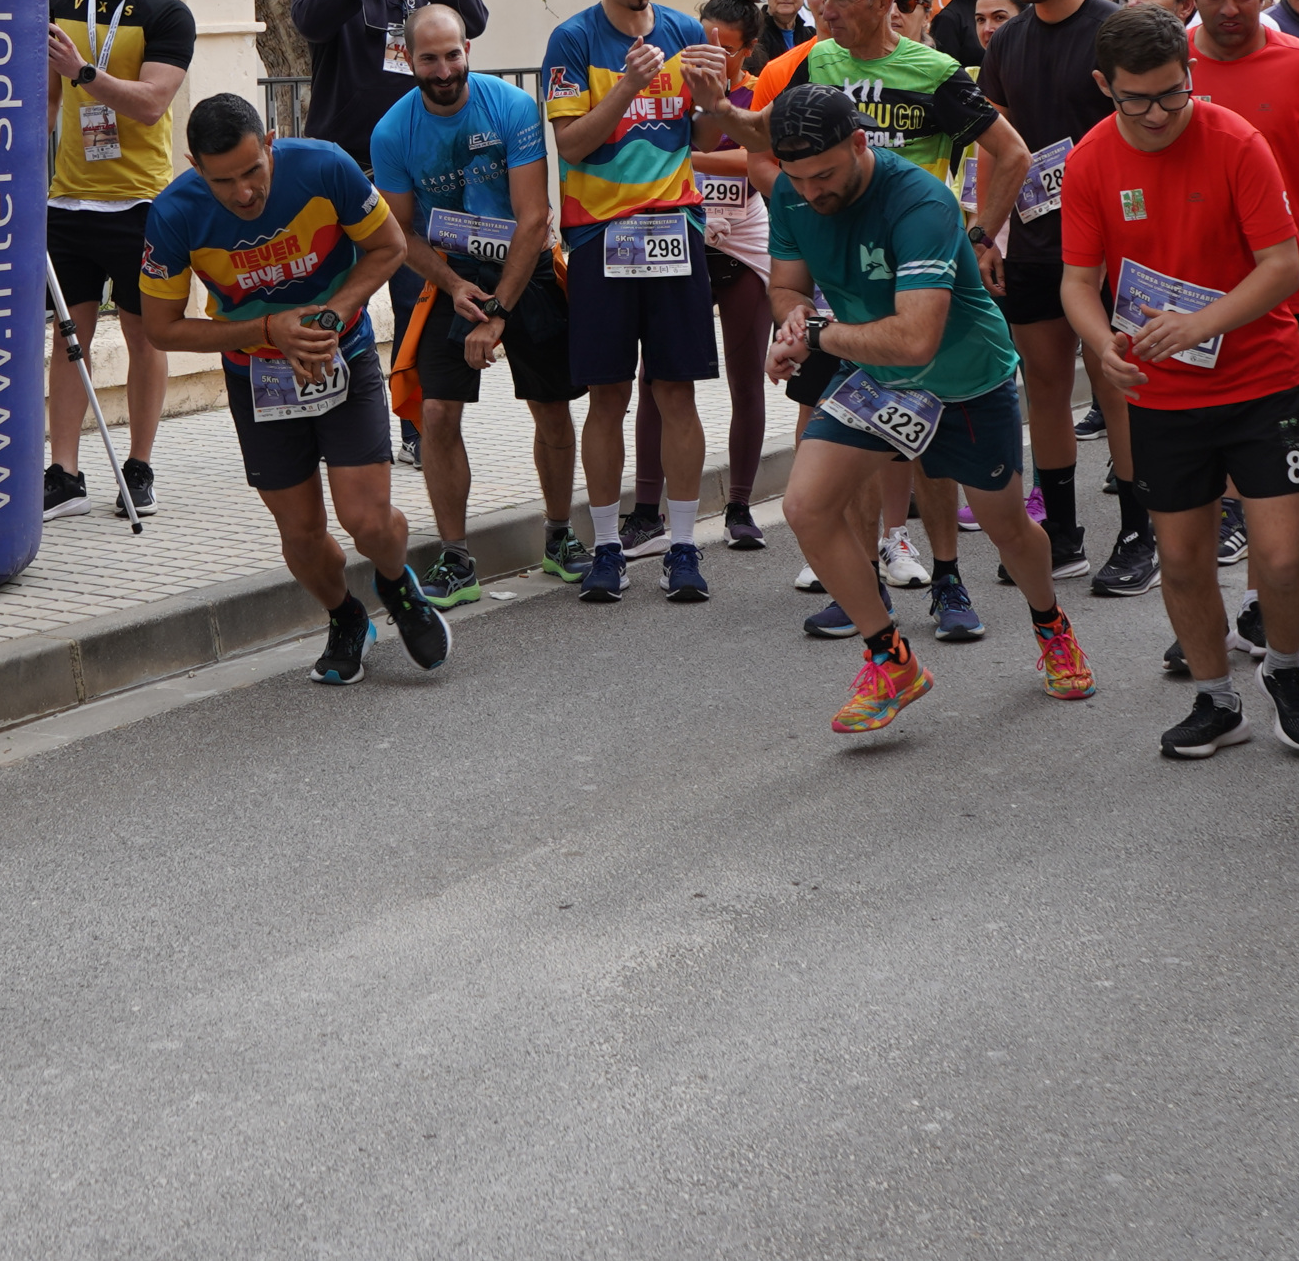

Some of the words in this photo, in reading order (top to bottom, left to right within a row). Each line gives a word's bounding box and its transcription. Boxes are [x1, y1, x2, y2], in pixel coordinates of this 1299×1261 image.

[123, 4, 134, 17] S
[622, 96, 656, 120] IVE
[661, 96, 684, 118] UP
[1042, 167, 1066, 193] 28
[704, 182, 741, 201] 299
[438, 230, 458, 239] 5Km
[228, 234, 302, 270] NEVER
[470, 239, 508, 260] 300
[646, 238, 682, 258] 298
[235, 264, 285, 290] GIVE
[290, 251, 319, 279] UP
[1129, 286, 1151, 303] 5Km
[261, 374, 280, 384] 5Km
[860, 379, 880, 399] 5Km
[877, 406, 926, 444] 323
